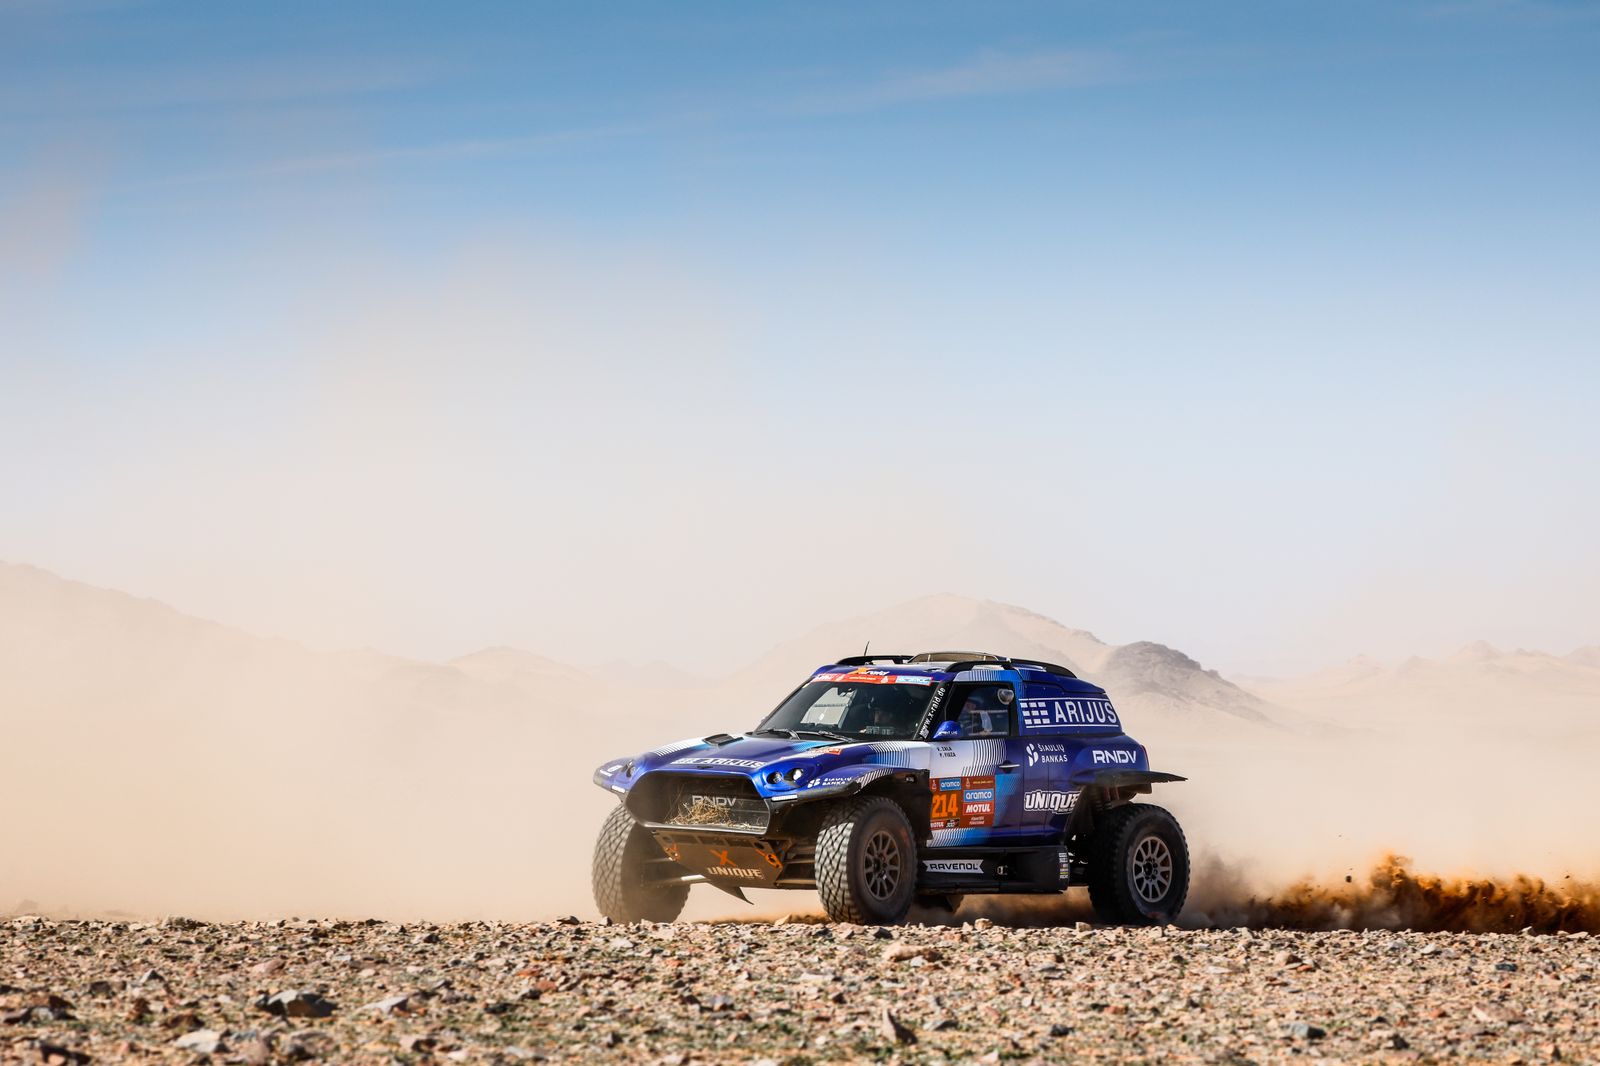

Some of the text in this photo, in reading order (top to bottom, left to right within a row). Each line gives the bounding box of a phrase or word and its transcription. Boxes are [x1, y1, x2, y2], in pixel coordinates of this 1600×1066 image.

[1056, 701, 1117, 724] ARIJUS
[1038, 743, 1065, 753] ŠIAULIŲ
[1042, 755, 1068, 763] BANKAS
[1092, 750, 1137, 764] RNDV
[966, 791, 992, 800] aramco
[1025, 791, 1080, 811] UNIQUE
[931, 793, 959, 818] 214
[965, 804, 991, 814] MOTUL
[707, 866, 762, 878] UNIQUE
